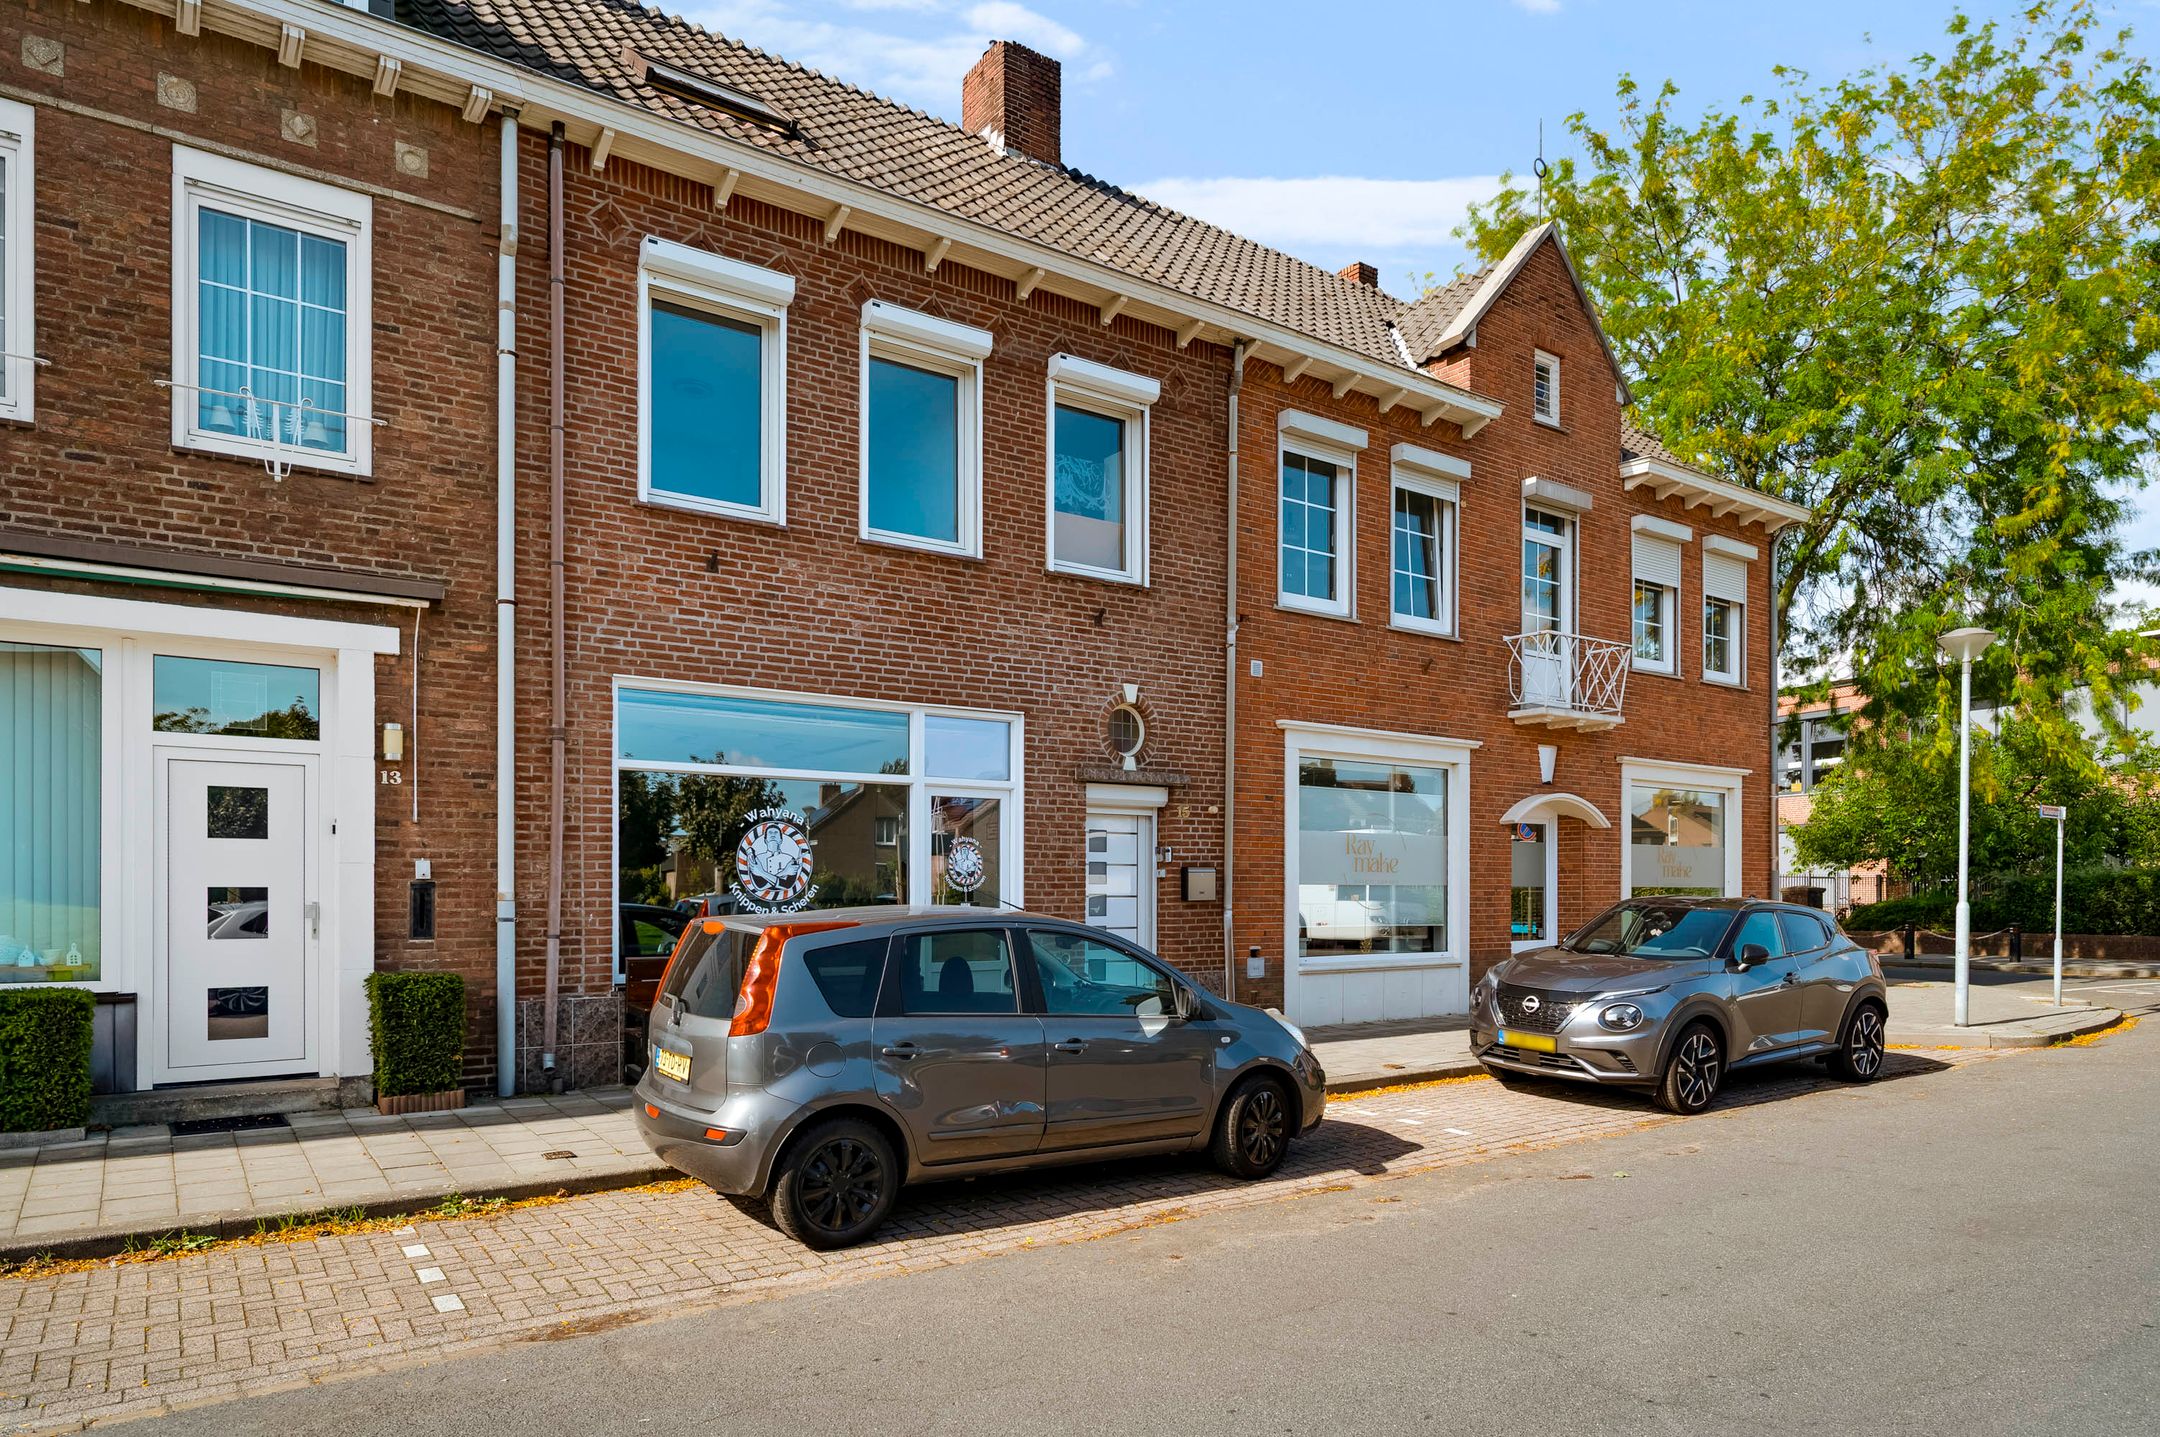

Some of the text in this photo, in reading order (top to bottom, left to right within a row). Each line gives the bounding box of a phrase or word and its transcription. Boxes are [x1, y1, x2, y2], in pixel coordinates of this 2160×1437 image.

[380, 770, 402, 785] 13
[744, 806, 804, 825] Wahyana
[1177, 805, 1190, 818] 15
[1345, 832, 1376, 858] Ray
[729, 882, 819, 915] Knippen & Scheren
